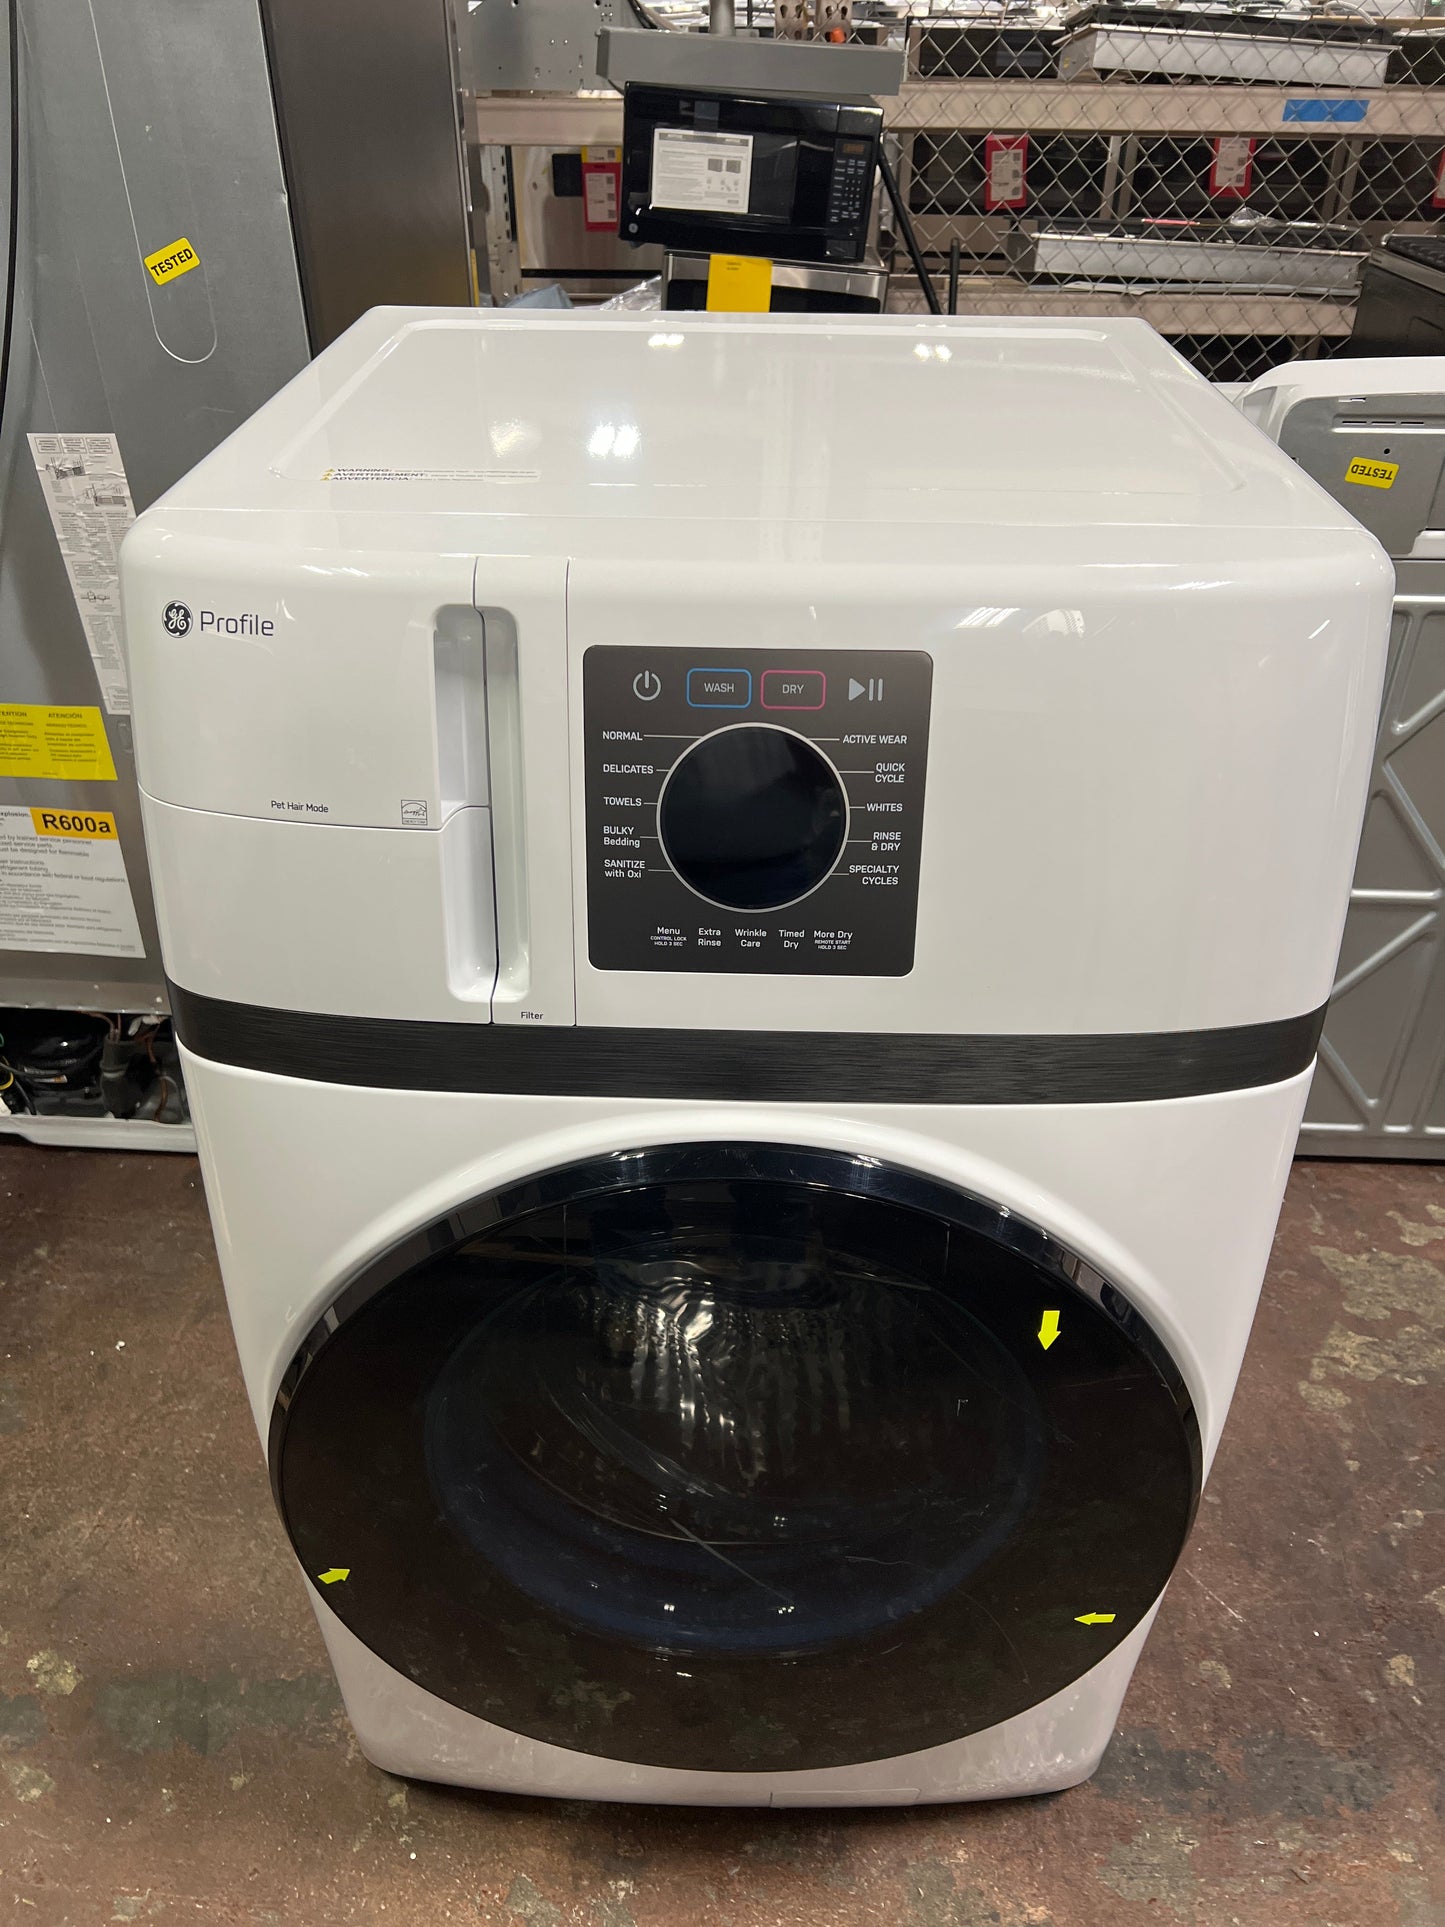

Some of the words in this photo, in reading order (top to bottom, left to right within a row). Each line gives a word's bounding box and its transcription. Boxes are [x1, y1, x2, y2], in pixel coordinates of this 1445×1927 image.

[151, 249, 193, 276] TESTED
[1351, 464, 1393, 480] TESTED
[201, 611, 274, 636] Profile
[704, 683, 734, 693] WASH
[782, 684, 804, 694] DRY
[602, 731, 643, 741] NORMAL
[843, 735, 875, 745] ACTIVE
[878, 735, 907, 745] WEAR
[603, 764, 653, 775] DELICATES
[876, 762, 905, 773] QUICK
[875, 774, 905, 784] CYCLE
[271, 801, 286, 810] Pet
[287, 802, 304, 811] Hair
[306, 803, 329, 813] Mode
[604, 797, 642, 807] TOWELS
[867, 802, 903, 812] WHITES
[42, 813, 111, 833] R600a
[603, 826, 634, 836] BULKY
[873, 831, 901, 841] RINSE
[604, 837, 640, 849] Bedding
[871, 842, 879, 851] &
[881, 842, 901, 852] DRY
[604, 859, 645, 869] SANITIZE
[849, 864, 899, 874] SPECIALTY
[605, 869, 625, 878] with
[628, 869, 642, 879] Oxi
[862, 876, 899, 886] CYCLES
[657, 927, 680, 935] Menu
[698, 928, 721, 936] Extra
[735, 929, 767, 937] Wrinkle
[838, 931, 853, 939] Dry
[698, 939, 721, 947] Rinse
[784, 941, 798, 950] Dry
[520, 1011, 544, 1020] Filter
